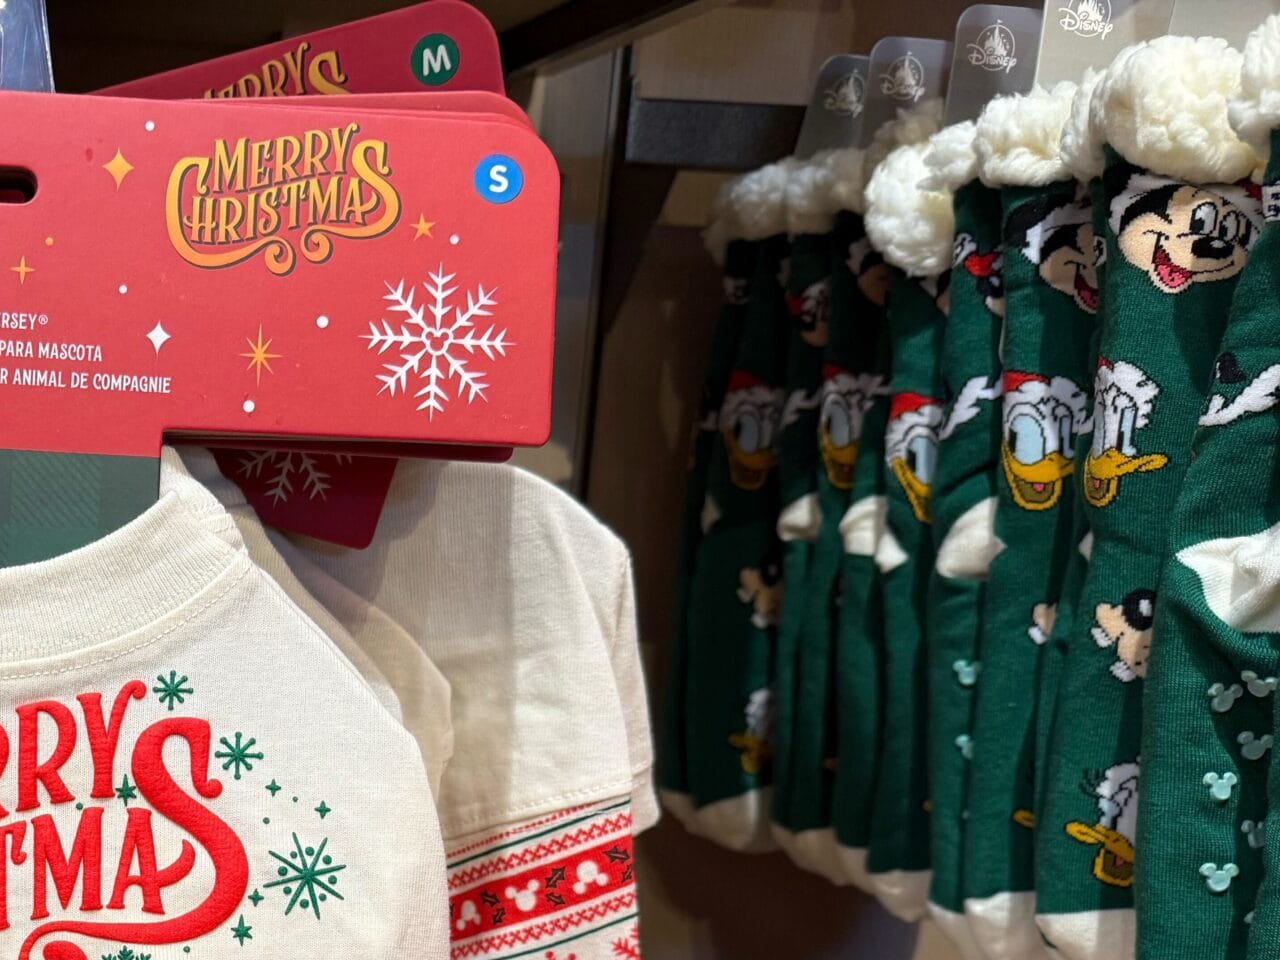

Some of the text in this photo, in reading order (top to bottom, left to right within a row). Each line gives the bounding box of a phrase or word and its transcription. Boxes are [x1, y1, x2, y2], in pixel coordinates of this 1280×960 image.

[422, 43, 452, 77] M
[211, 121, 361, 195] MERRY
[487, 164, 510, 194] S
[165, 138, 402, 277] CHRISTMAS
[38, 342, 103, 362] MASCOTA
[12, 368, 66, 388] ANIMAL
[70, 371, 90, 389] DE
[92, 372, 172, 394] COMPAGNIE
